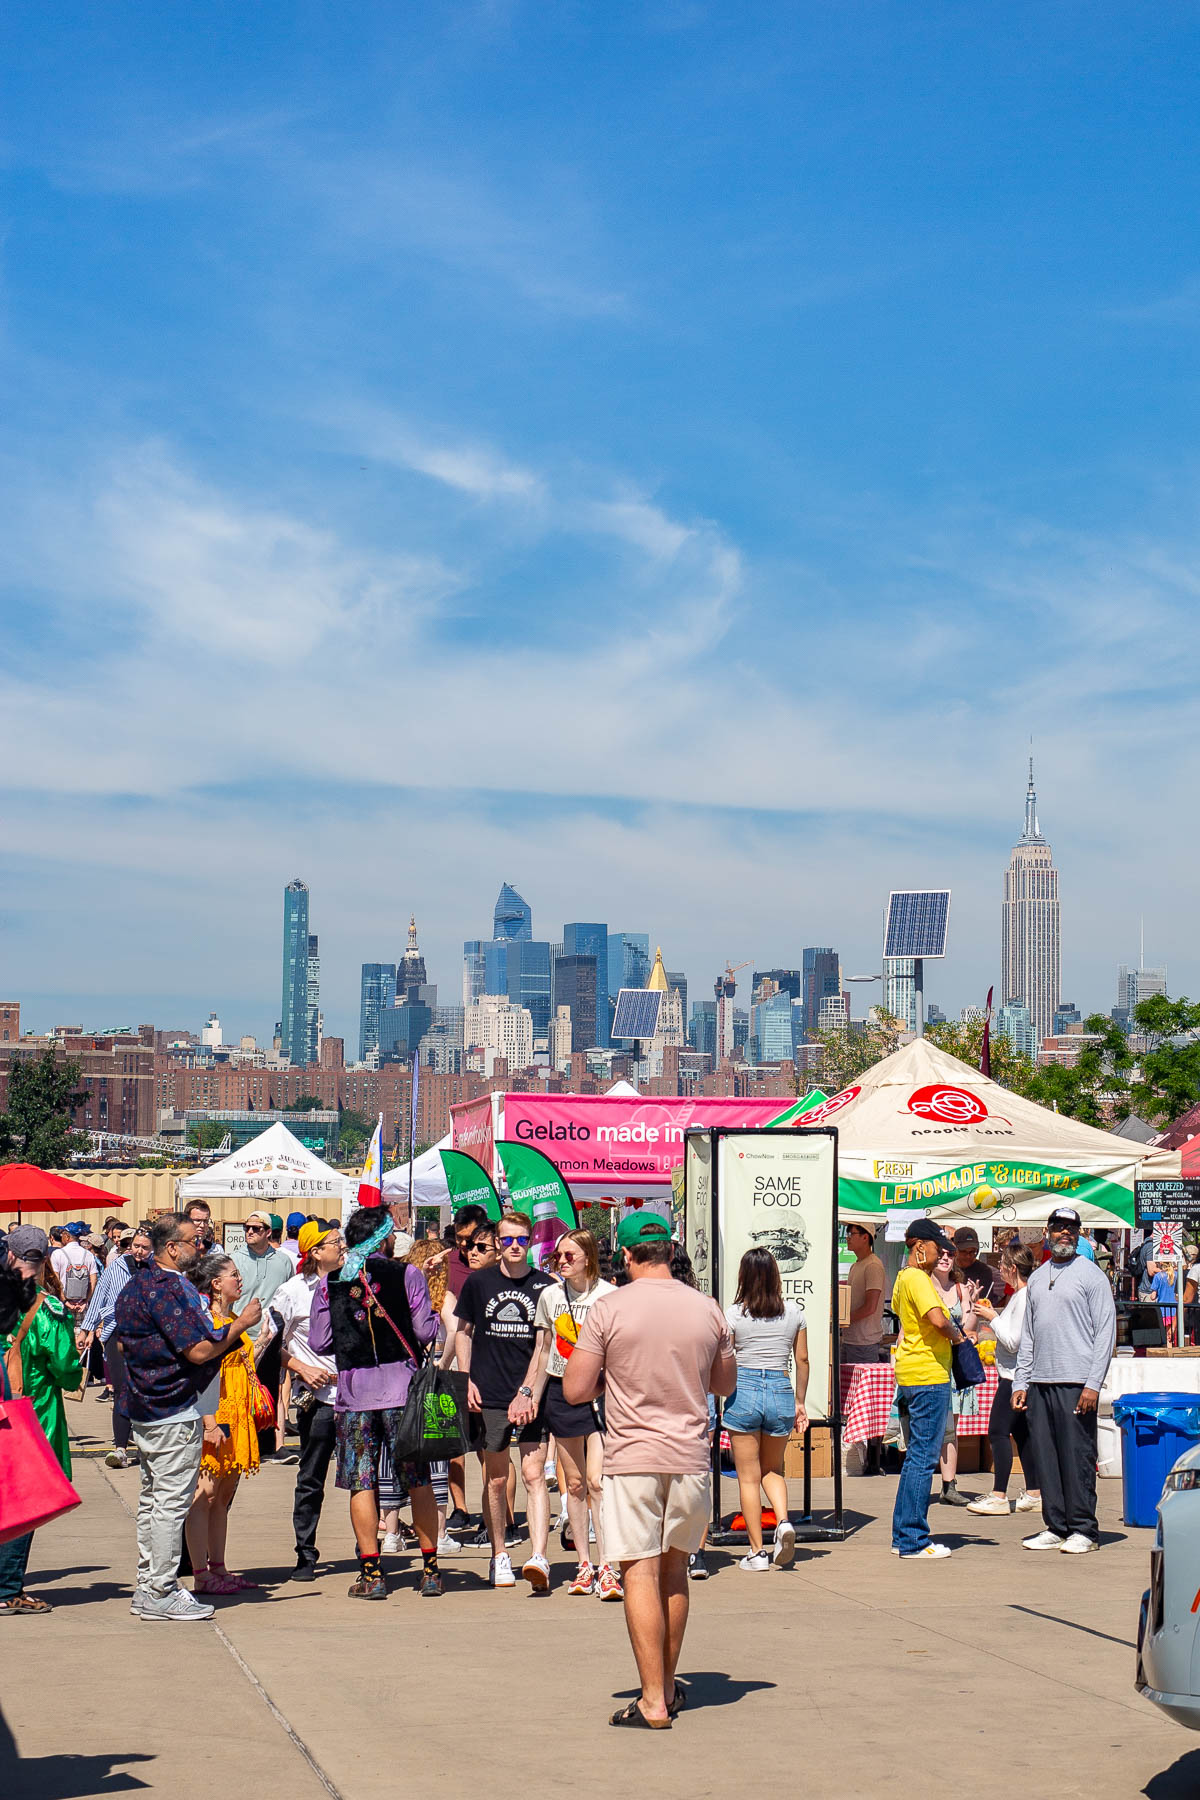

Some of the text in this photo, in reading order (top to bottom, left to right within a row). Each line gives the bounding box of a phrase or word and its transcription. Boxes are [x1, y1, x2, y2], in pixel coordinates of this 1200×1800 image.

[515, 1119, 684, 1143] Gelato made in
[593, 1158, 656, 1171] Meadows
[873, 1159, 913, 1178] FRESH
[230, 1179, 333, 1191] JOHN'S JUICE
[511, 1182, 560, 1200] BODYARMOR
[754, 1176, 801, 1191] SAME
[879, 1163, 987, 1205] LEMONADE
[1012, 1169, 1041, 1185] ICED
[1044, 1173, 1071, 1189] TEA
[1137, 1182, 1154, 1191] FRESH
[453, 1186, 490, 1202] BODYARMOR
[753, 1193, 801, 1207] FOOD
[226, 1235, 245, 1243] ORD
[485, 1290, 536, 1321] THE EXCHANGE
[490, 1322, 530, 1333] RUNNING
